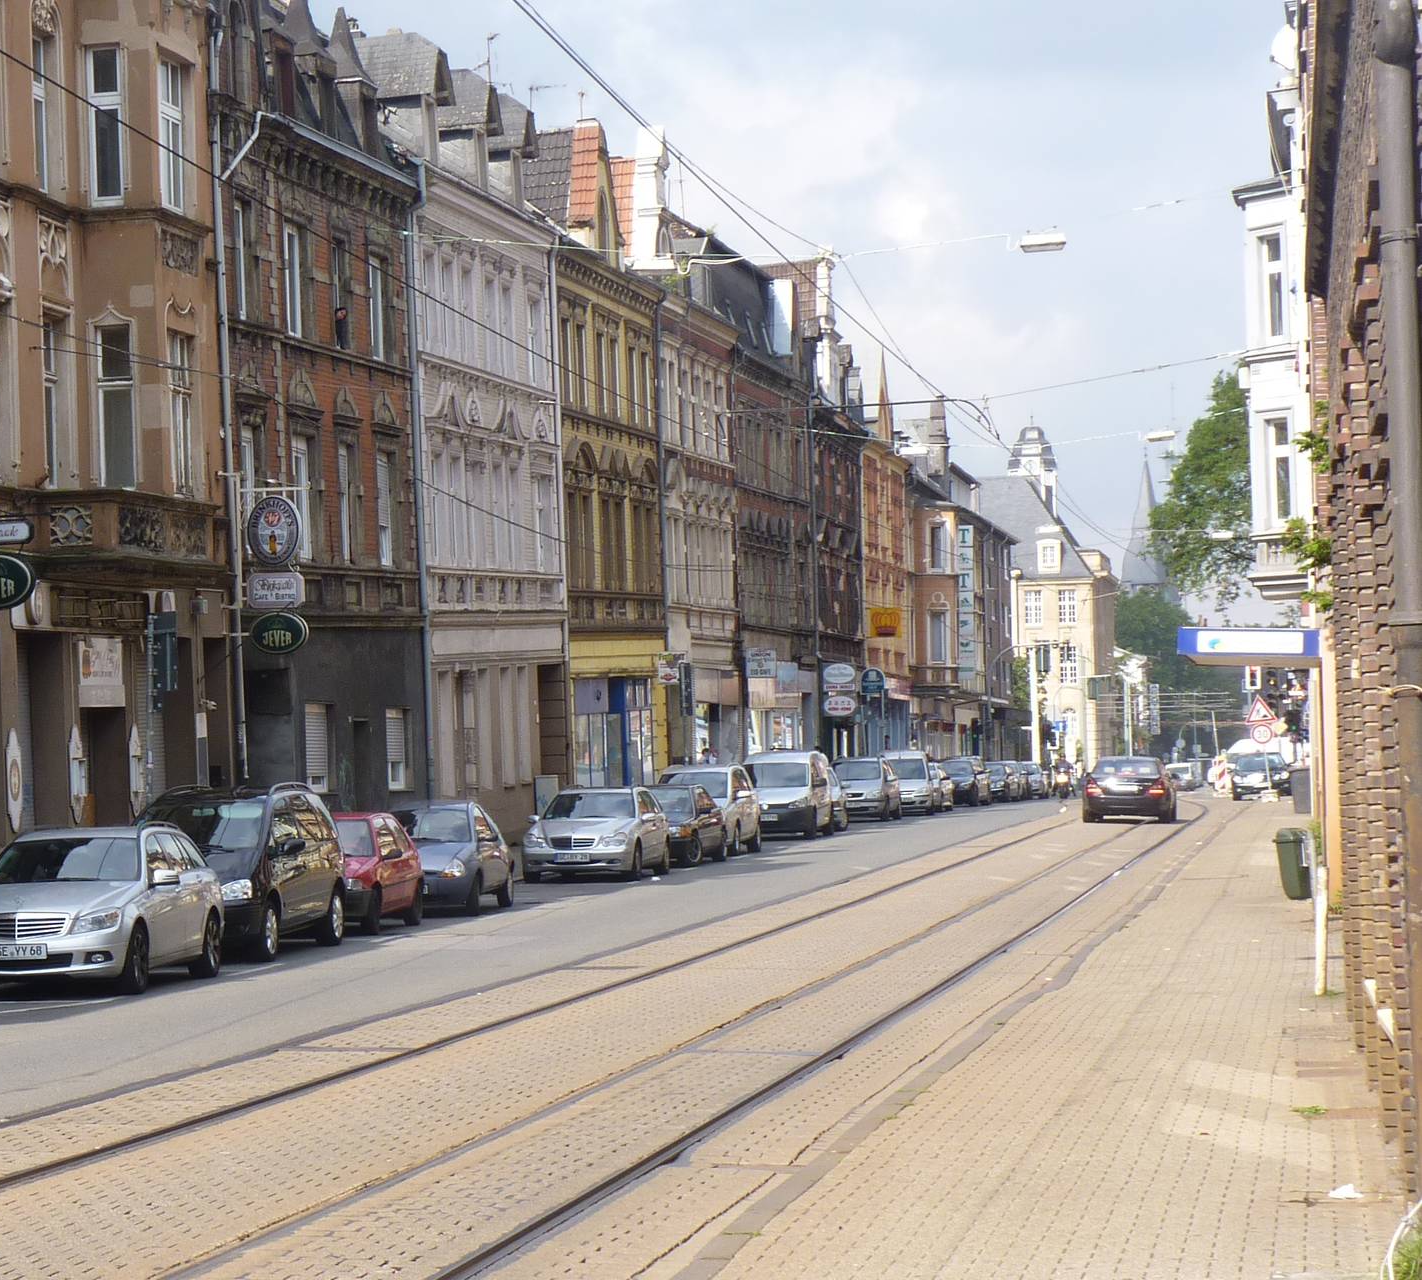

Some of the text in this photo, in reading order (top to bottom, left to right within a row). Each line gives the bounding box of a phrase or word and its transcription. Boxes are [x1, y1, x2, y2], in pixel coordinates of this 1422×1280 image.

[262, 629, 293, 649] JEVER
[14, 946, 28, 956] YY
[29, 945, 42, 956] 68
